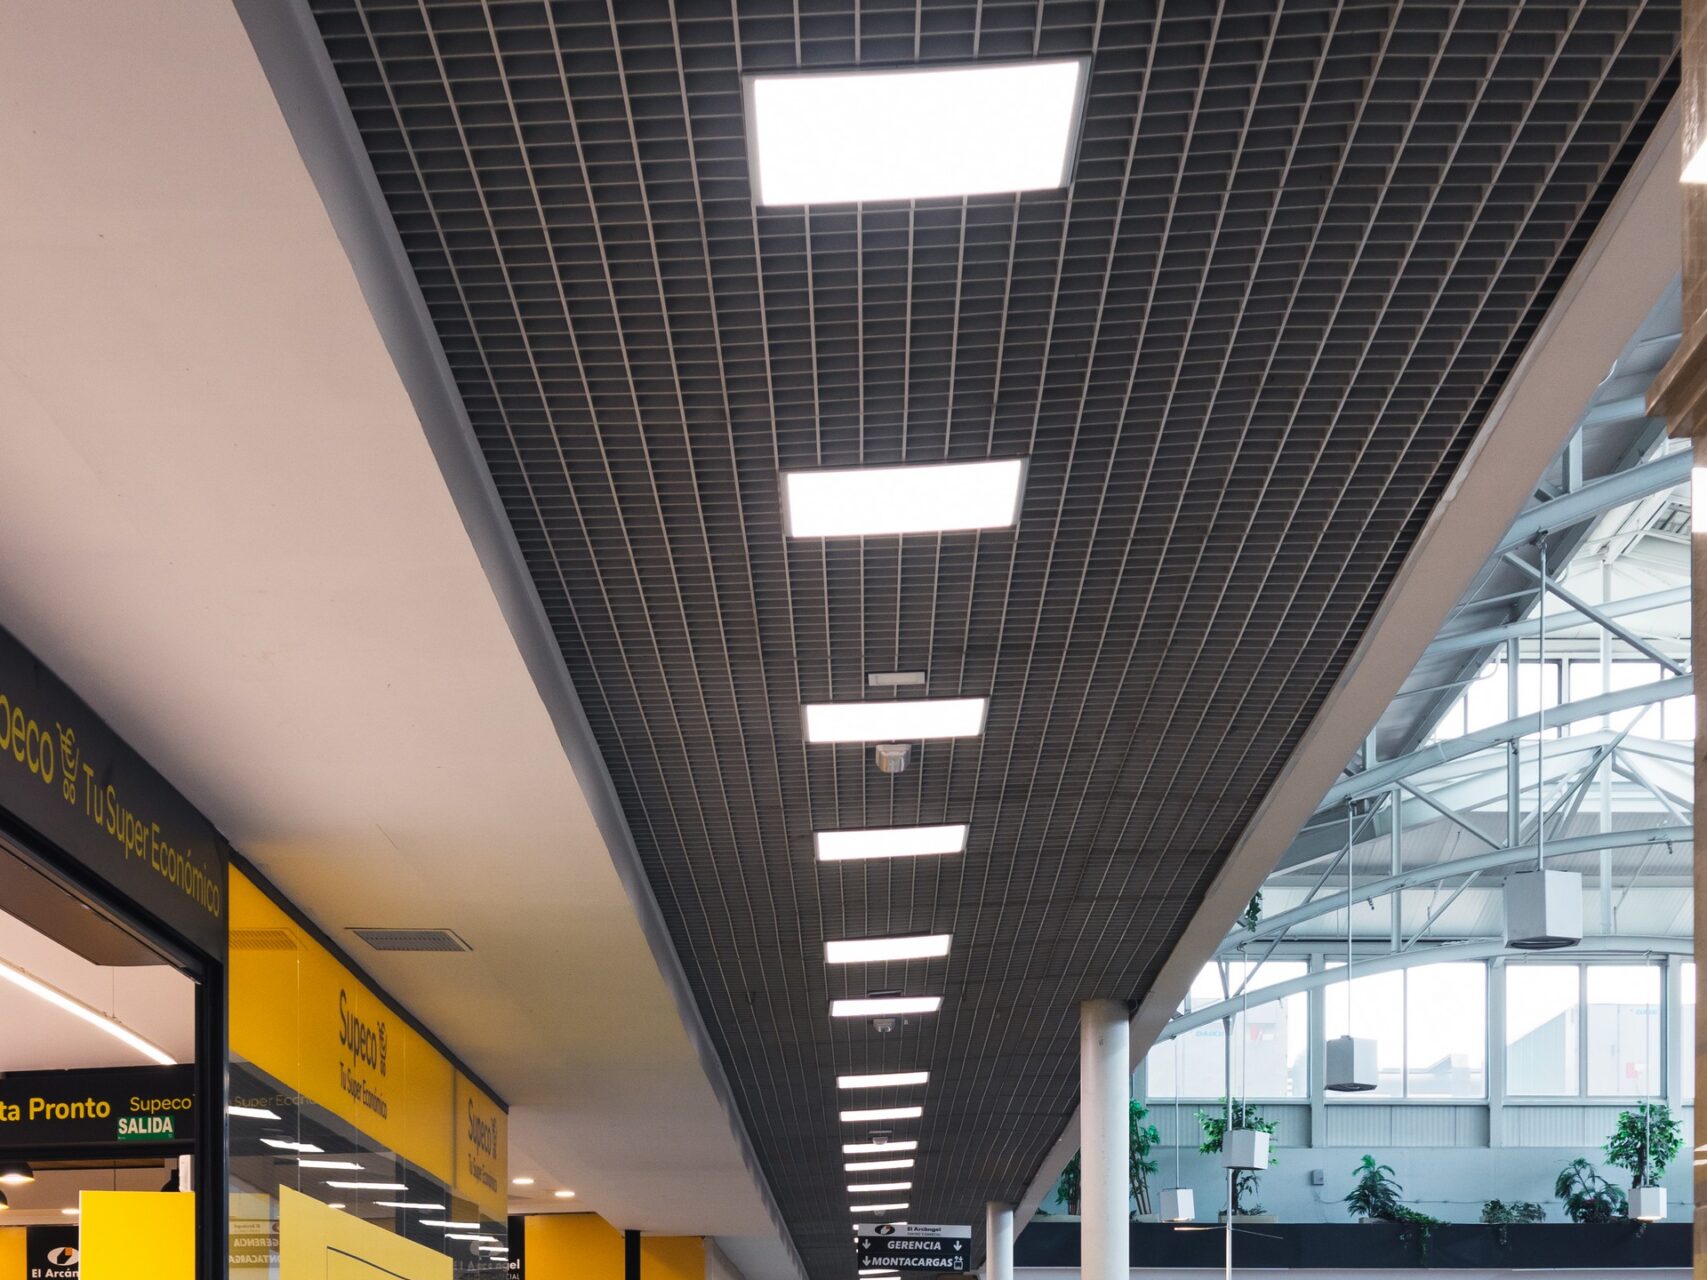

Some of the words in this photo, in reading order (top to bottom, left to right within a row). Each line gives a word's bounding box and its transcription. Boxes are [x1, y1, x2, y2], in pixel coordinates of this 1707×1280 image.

[83, 763, 103, 826] Tu
[106, 785, 149, 859] Super
[151, 822, 220, 917] Económico
[339, 989, 377, 1070] Supeco
[29, 1097, 111, 1121] Pronto
[130, 1096, 192, 1114] Supeco
[118, 1116, 174, 1135] SALIDA
[468, 1098, 491, 1156] Supeco
[887, 1240, 942, 1250] GERENCIA
[872, 1256, 953, 1267] MONTACARGAS
[32, 1268, 41, 1278] El
